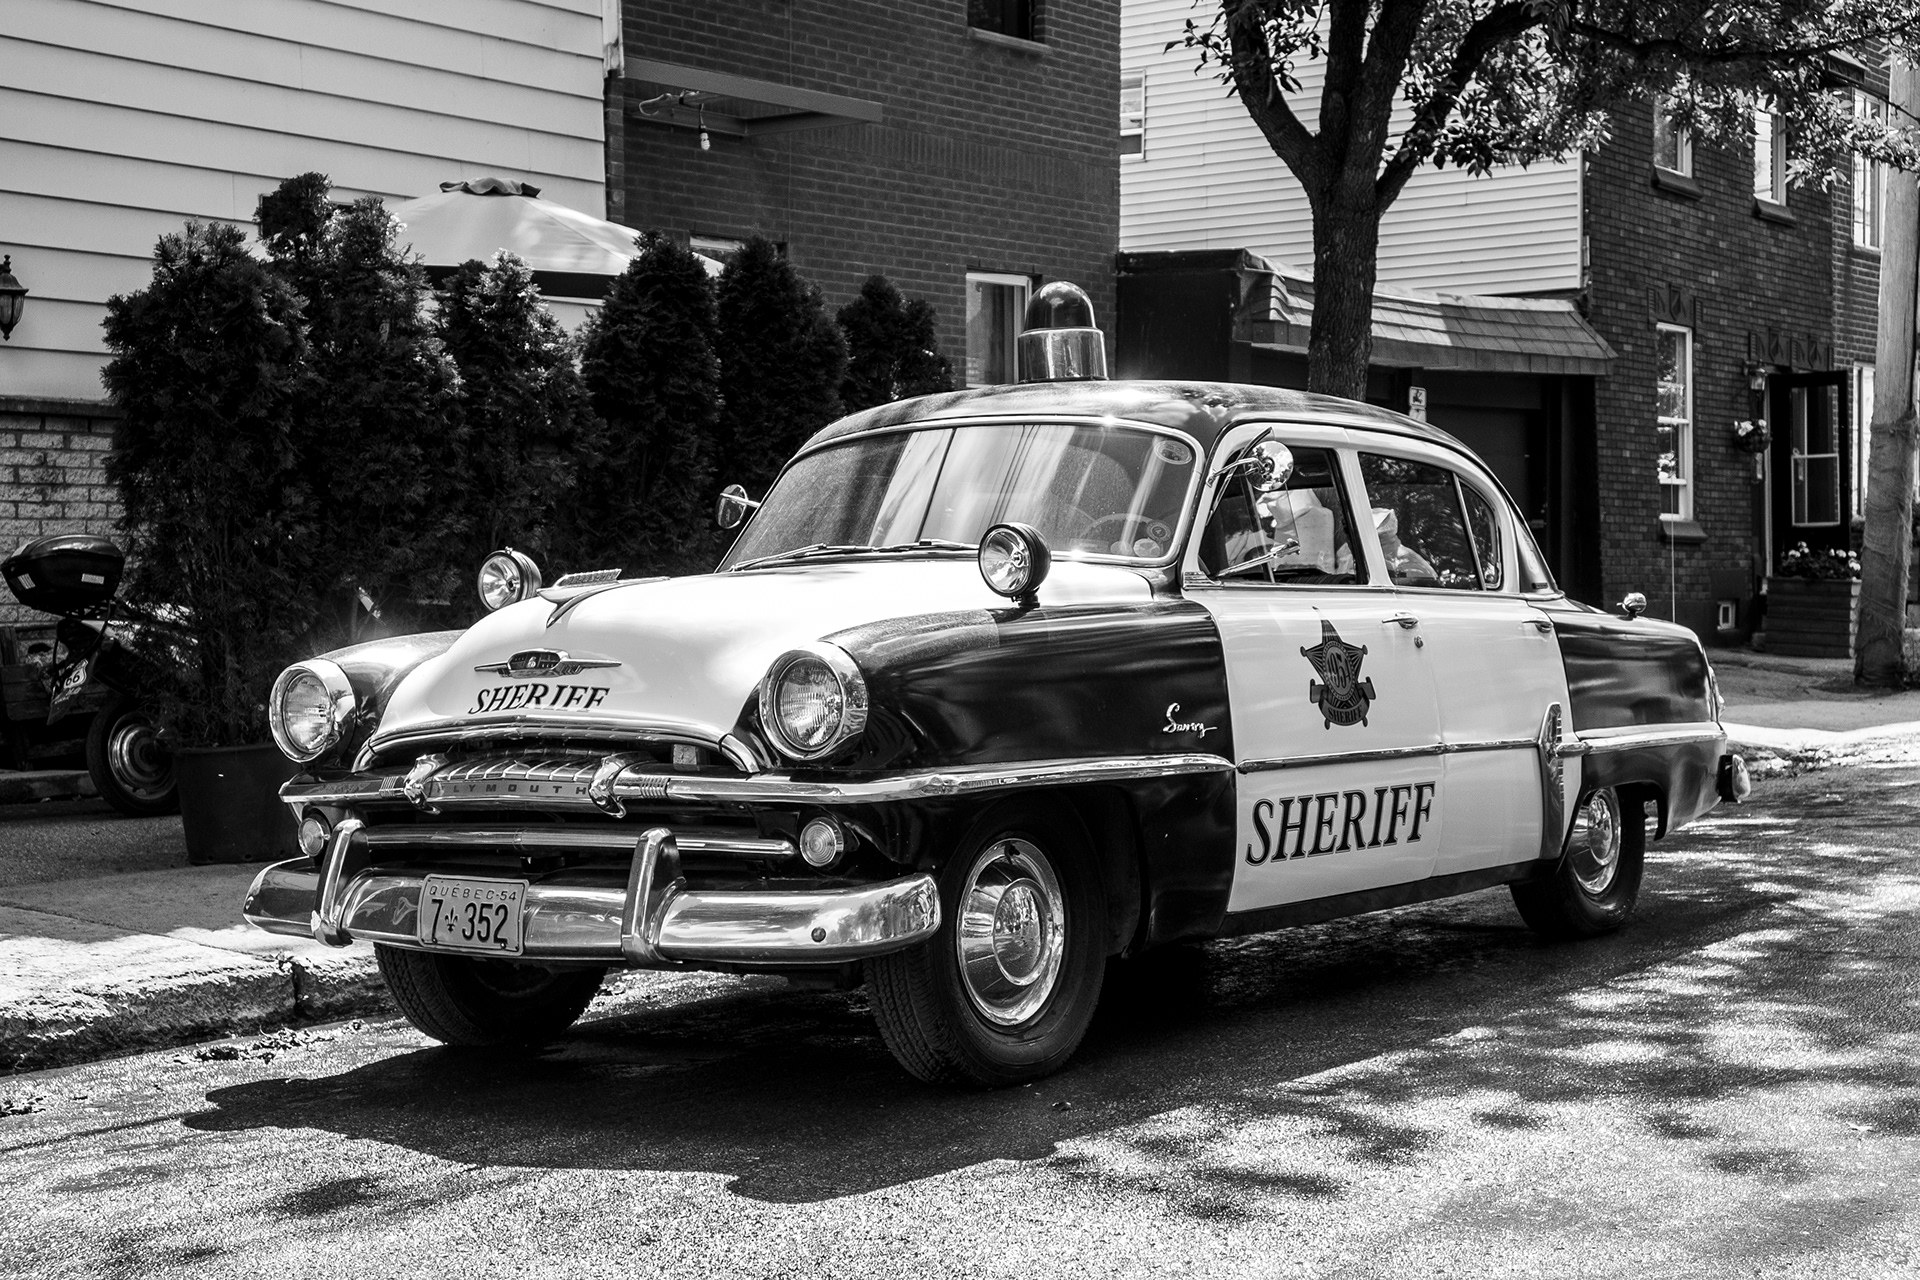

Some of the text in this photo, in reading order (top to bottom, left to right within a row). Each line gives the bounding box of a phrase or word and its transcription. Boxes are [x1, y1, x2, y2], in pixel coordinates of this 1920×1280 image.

[467, 683, 611, 714] SHERIFF
[1328, 704, 1363, 723] SHERIFF
[1245, 780, 1436, 866] SHERIFF
[462, 902, 509, 944] 352
